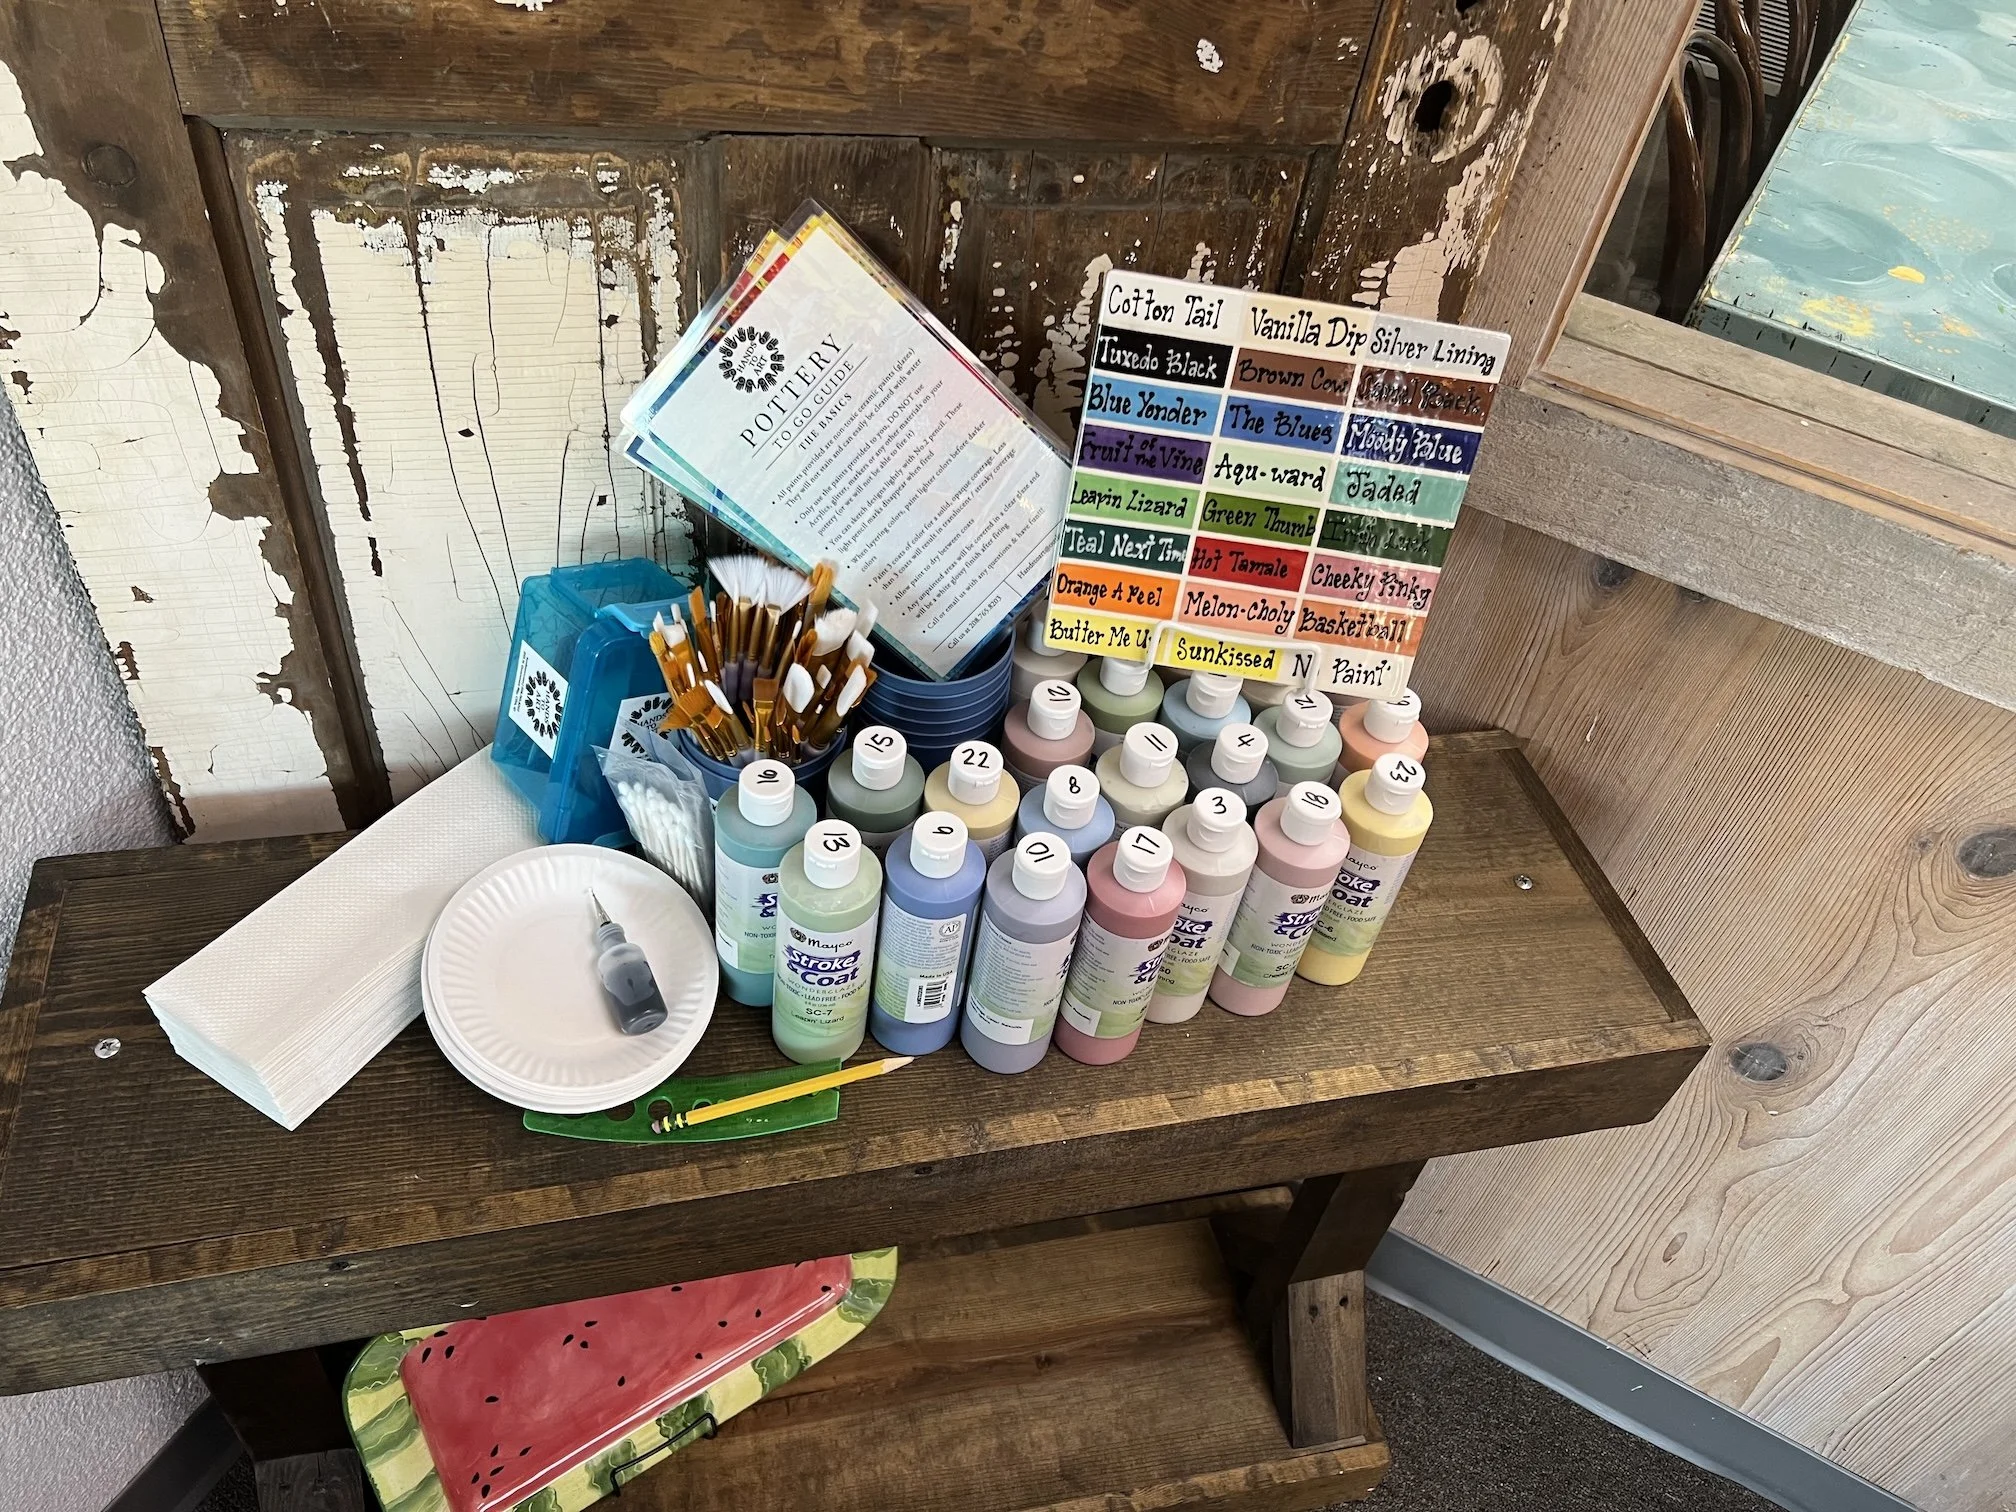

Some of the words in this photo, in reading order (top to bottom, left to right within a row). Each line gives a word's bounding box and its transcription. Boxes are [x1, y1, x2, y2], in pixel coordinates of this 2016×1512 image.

[1108, 285, 1175, 323] Cotton
[1184, 294, 1224, 329] Tail
[1251, 306, 1321, 346] Vanilla
[1325, 316, 1368, 356] Dip
[736, 342, 757, 373] HANDS
[749, 356, 758, 366] TO
[754, 354, 767, 376] ART
[1099, 335, 1158, 370] Tuxedo
[1166, 349, 1218, 380] Black
[1370, 327, 1428, 360] Silver
[1432, 339, 1496, 376] Lining
[739, 333, 841, 448] POTTERY
[1238, 358, 1304, 388] Brown
[1311, 366, 1348, 394] Cow
[771, 430, 792, 449] TO
[793, 407, 812, 428] GO
[813, 360, 854, 405] GUIDE
[1087, 382, 1132, 415] Blue
[1136, 391, 1208, 426] Yonder
[777, 489, 788, 501] All
[786, 473, 803, 494] paints
[801, 447, 826, 476] provided
[824, 439, 834, 450] are
[857, 389, 879, 413] ceramic
[877, 370, 895, 392] paints
[892, 347, 916, 373] (glazes)
[784, 492, 802, 508] They
[799, 480, 812, 493] will
[810, 471, 821, 483] not
[819, 458, 834, 472] stain
[832, 444, 844, 459] and
[842, 436, 854, 448] can
[864, 411, 875, 421] be
[874, 388, 895, 413] cleaned
[893, 375, 907, 390] with
[905, 358, 922, 376] water
[798, 429, 819, 450] THE
[818, 392, 852, 429] BASICS
[1230, 404, 1264, 433] The
[1274, 411, 1333, 444] Blues
[799, 505, 815, 520] Only
[813, 495, 824, 506] use
[822, 486, 833, 497] the
[831, 468, 849, 489] paints
[847, 442, 871, 472] provided
[869, 436, 878, 445] to
[886, 410, 900, 424] DO
[897, 392, 914, 413] NOT
[914, 384, 925, 396] use
[1079, 430, 1134, 462] Fruit
[1140, 437, 1158, 450] of
[1160, 446, 1204, 475] Vine
[1346, 422, 1408, 462] Moody
[1412, 430, 1463, 464] Blue
[828, 534, 843, 546] You
[841, 524, 852, 535] can
[850, 506, 869, 525] sketch
[866, 486, 887, 508] designs
[883, 468, 904, 488] lightly
[902, 455, 916, 469] with
[912, 438, 930, 456] No.2
[944, 402, 963, 420] These
[1213, 452, 1326, 492] Aqu-ward
[1346, 471, 1422, 506] Jaded
[837, 540, 853, 554] light
[851, 521, 868, 543] pencil
[866, 507, 884, 525] marks
[881, 480, 907, 508] disappear
[906, 465, 922, 482] when
[919, 449, 935, 467] fired
[1070, 480, 1122, 510] Leapin
[1126, 490, 1188, 518] Lizard
[1202, 498, 1257, 528] Green
[1264, 506, 1316, 538] Thumb
[1064, 525, 1104, 554] Teal
[1110, 533, 1156, 561] Next
[1192, 546, 1222, 572] Hot
[1229, 550, 1288, 579] Tamale
[1056, 573, 1107, 606] Orange
[1111, 582, 1124, 600] A
[1126, 584, 1162, 606] Peel
[1312, 563, 1375, 602] Cheeky
[1378, 570, 1432, 610] Pinky
[1049, 618, 1104, 646] Butter
[1108, 626, 1130, 648] Me
[1136, 629, 1161, 649] U
[1298, 607, 1406, 643] Basketball
[947, 637, 960, 650] Call
[1176, 636, 1276, 669] Sunkissed
[865, 734, 894, 752] 15
[1144, 733, 1168, 752] 11
[1237, 733, 1255, 748] 4
[962, 748, 990, 768] 22
[1389, 760, 1418, 783] 23
[756, 769, 780, 785] 16
[1068, 775, 1081, 794] 8
[1211, 796, 1228, 814] 3
[1301, 791, 1330, 810] 18
[823, 832, 851, 852] 13
[1026, 842, 1054, 863] 10
[1131, 833, 1161, 855] 17
[1346, 852, 1377, 871] ayco
[1332, 888, 1374, 908] oat
[1318, 920, 1334, 933] C-6
[790, 949, 856, 972] Stroke
[808, 937, 854, 953] Mayco
[800, 966, 859, 986] Coat
[804, 994, 820, 1002] LEAD
[806, 1008, 833, 1016] SC-7
